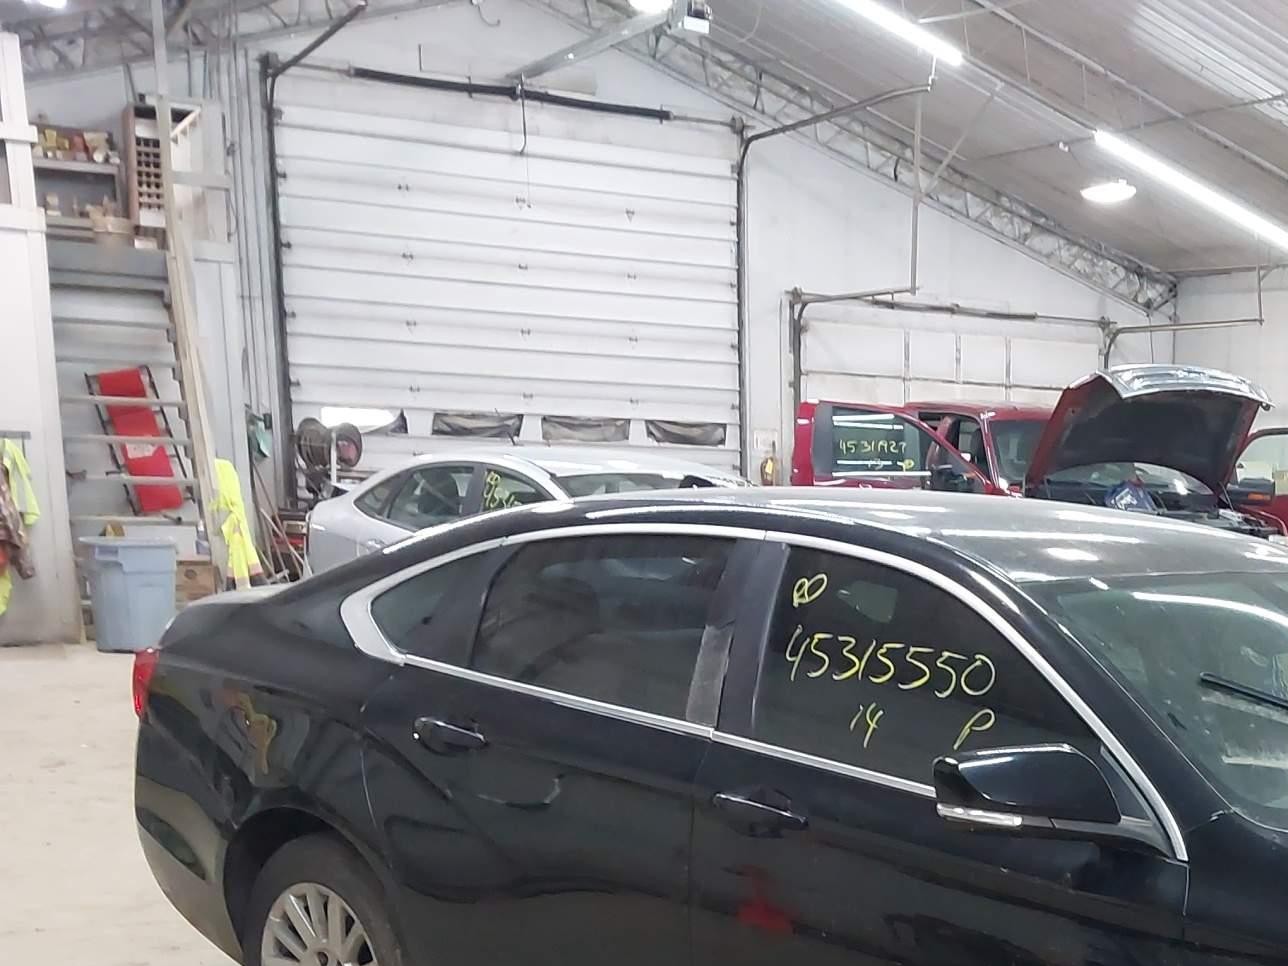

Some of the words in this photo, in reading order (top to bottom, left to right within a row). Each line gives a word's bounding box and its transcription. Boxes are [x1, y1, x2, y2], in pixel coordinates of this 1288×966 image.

[785, 624, 996, 699] 45315550
[849, 701, 884, 749] 14
[953, 708, 996, 750] P
